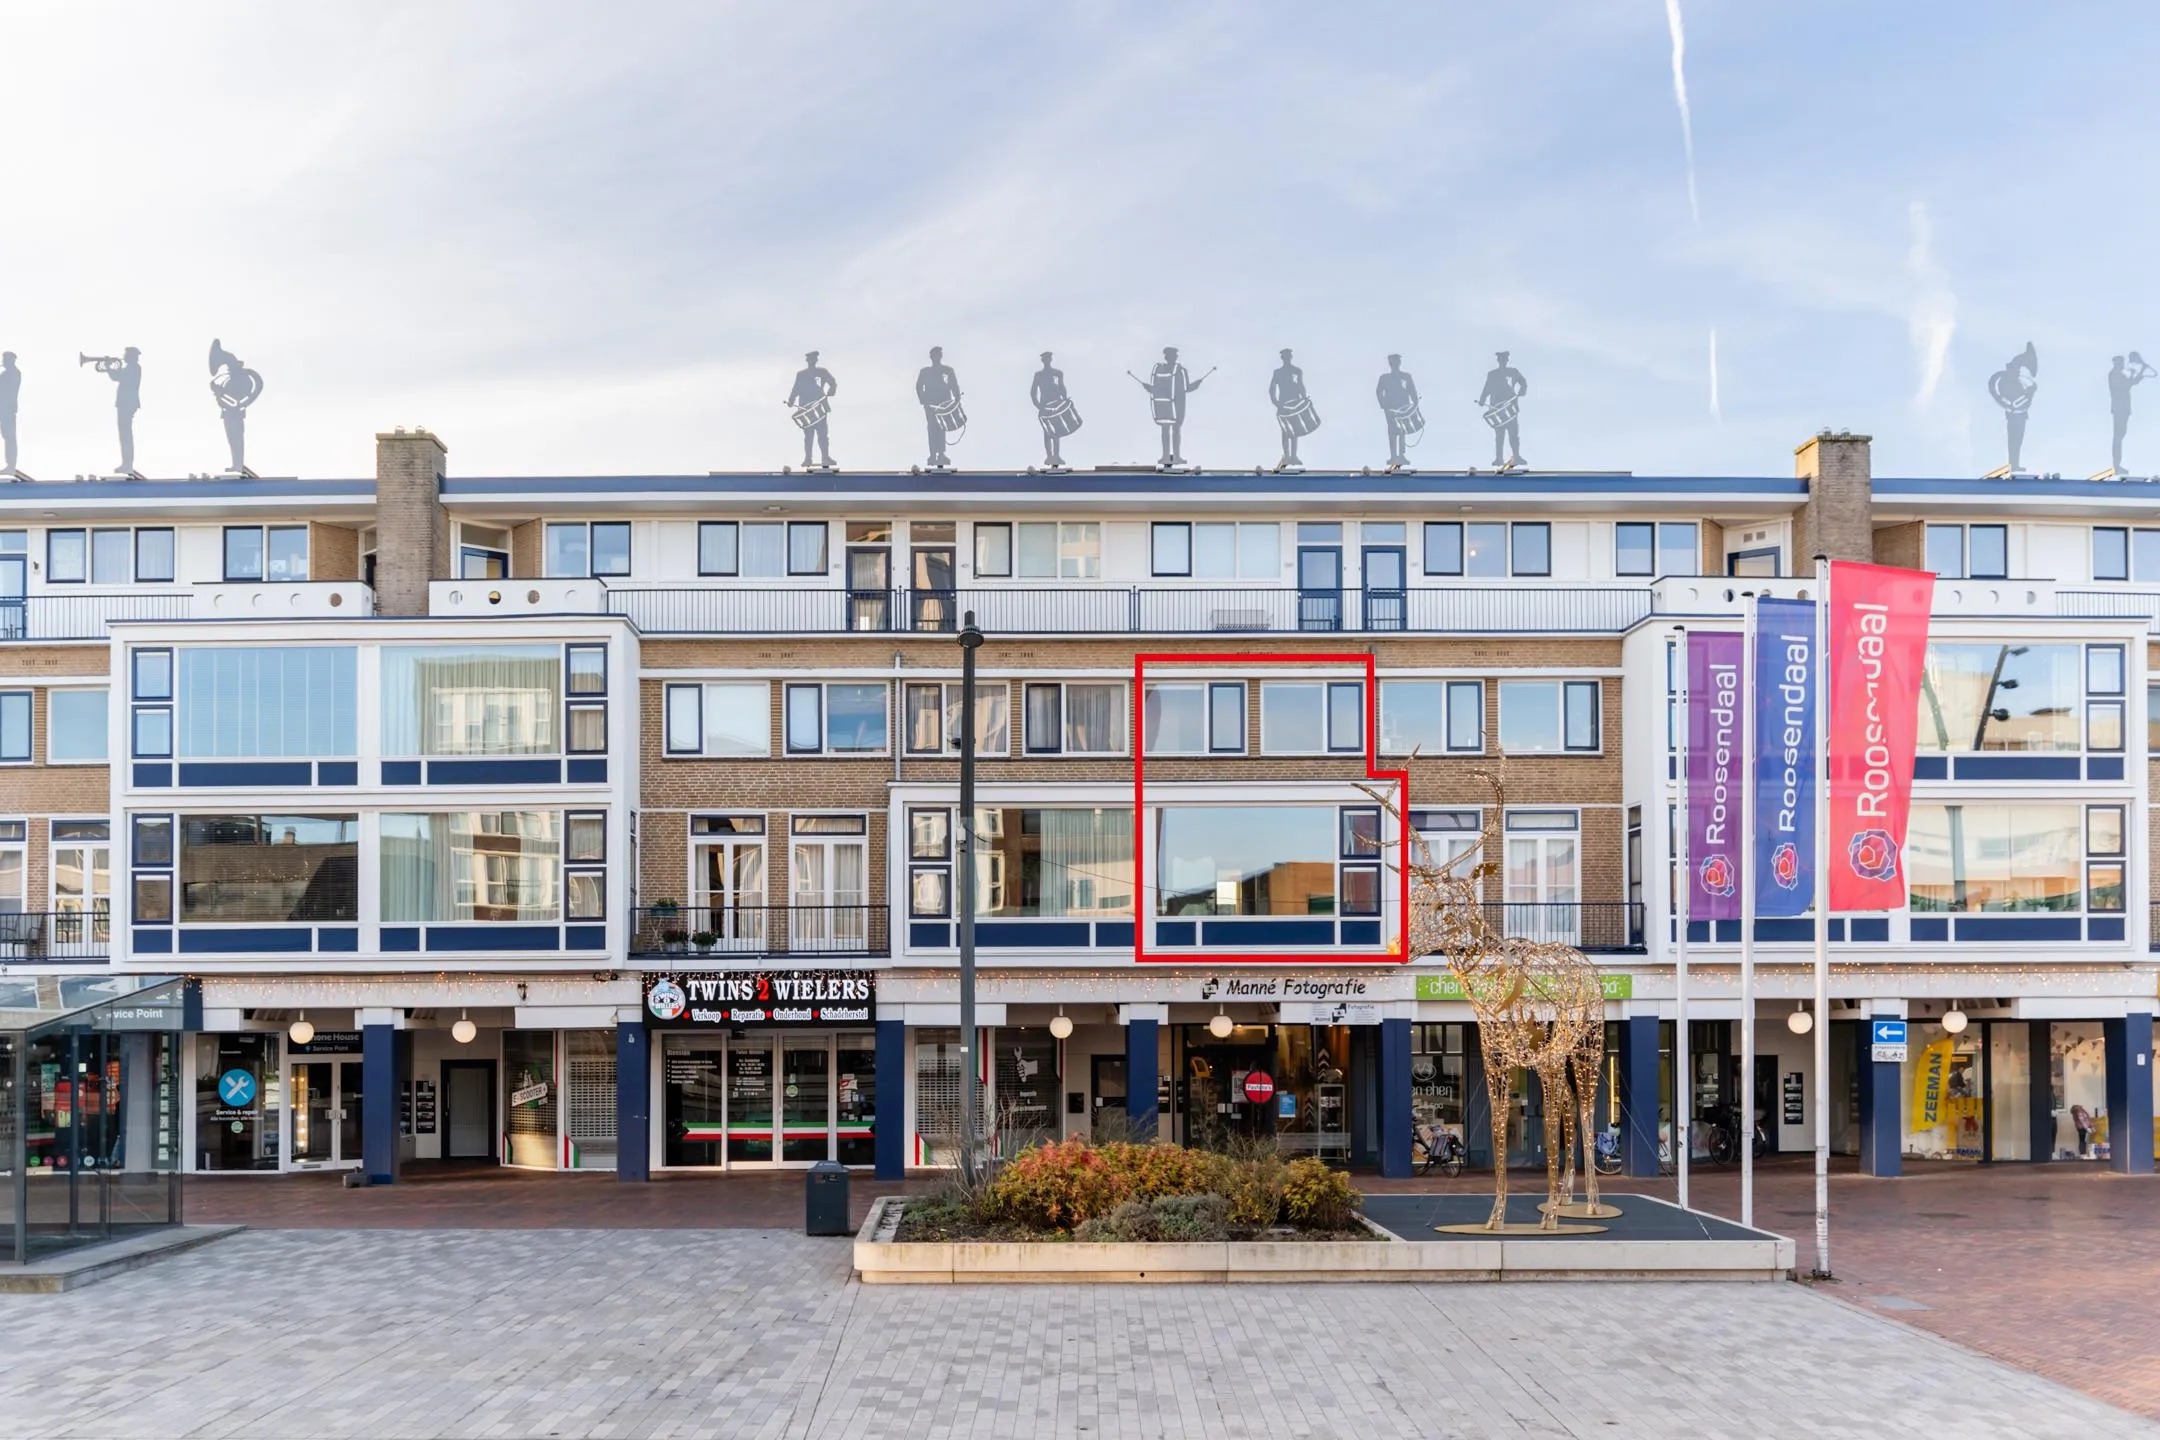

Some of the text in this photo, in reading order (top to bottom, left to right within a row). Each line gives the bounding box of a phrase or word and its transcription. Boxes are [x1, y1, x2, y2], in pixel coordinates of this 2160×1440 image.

[1778, 635, 1809, 832] Roosendaal
[1706, 664, 1737, 845] Roosendaal
[757, 978, 769, 1001] 2
[1226, 978, 1366, 999] Manné Fotografie
[136, 1009, 163, 1018] Point
[692, 1008, 868, 1023] Verkoop Reparatie Onderhoud Schadeherstel
[333, 1033, 359, 1041] House
[1925, 1053, 1943, 1122] ZEEMAN
